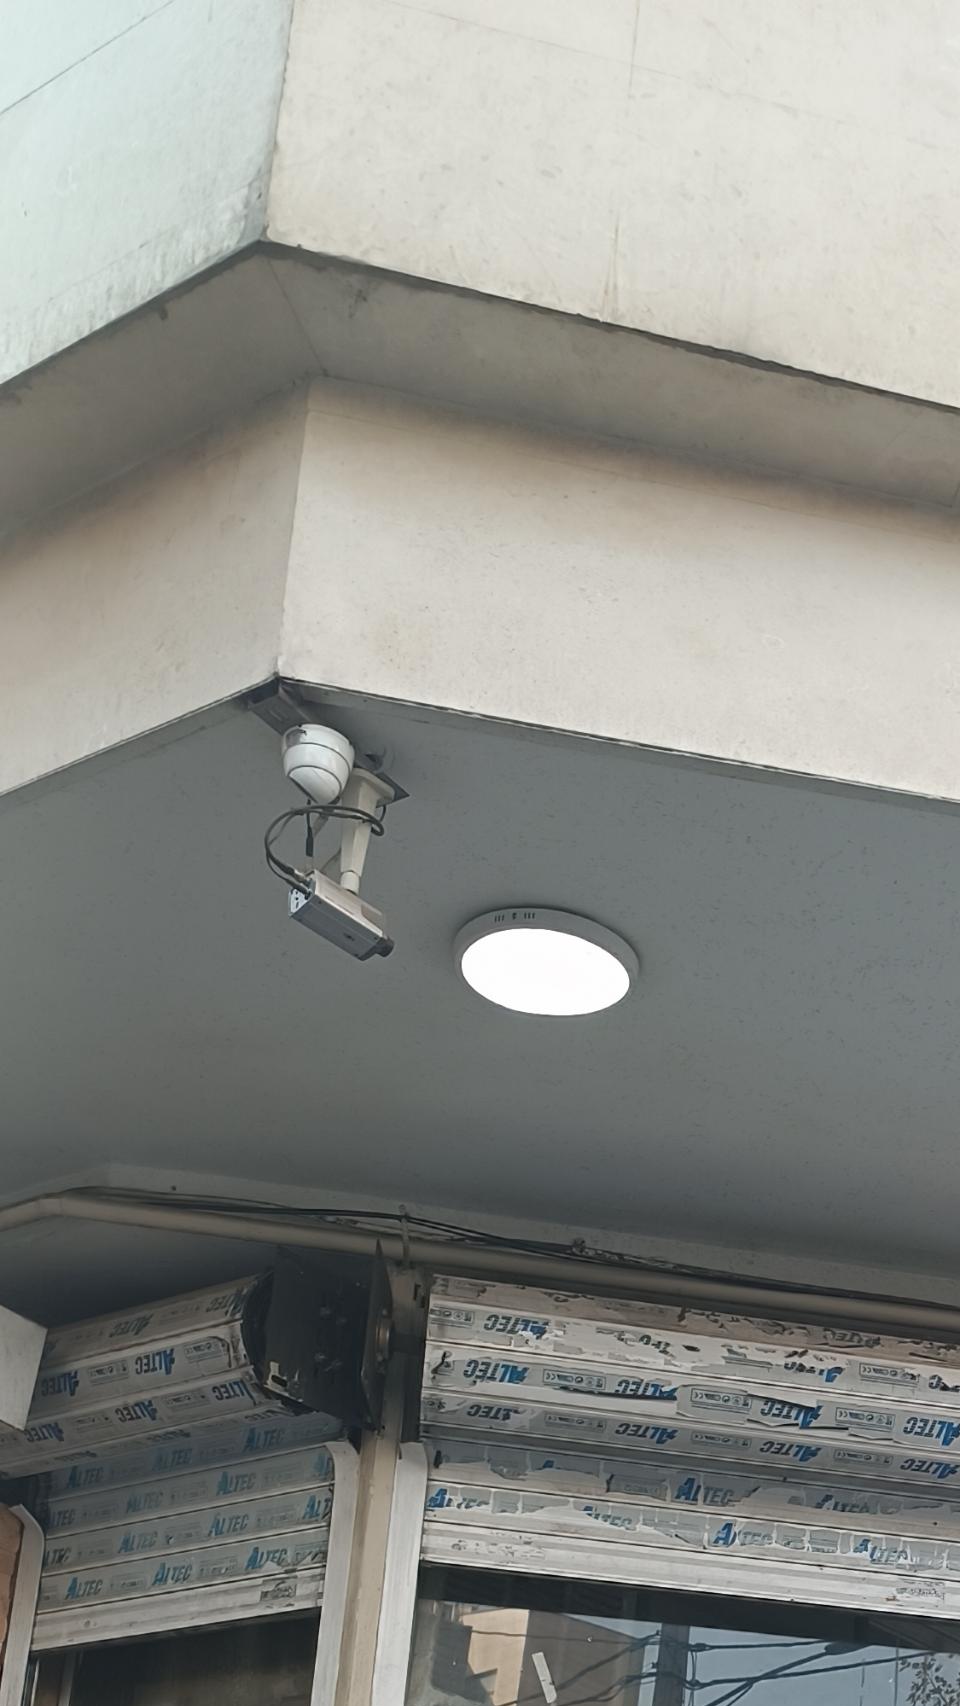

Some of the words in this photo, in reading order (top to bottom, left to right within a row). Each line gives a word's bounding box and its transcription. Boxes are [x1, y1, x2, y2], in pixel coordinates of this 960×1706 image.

[135, 1348, 175, 1375] ALTEC
[463, 1359, 530, 1385] ALTEC
[41, 1371, 79, 1396] ALTEC
[115, 1400, 158, 1422] ALTEC
[760, 1400, 823, 1430] ALTEC
[26, 1423, 64, 1442] ALTEC
[243, 1427, 283, 1451] ALTEC
[615, 1422, 679, 1445] ALTEC
[759, 1440, 822, 1463] ALTEC
[67, 1465, 104, 1489] ALTEC
[900, 1458, 960, 1480] ALTEC
[216, 1471, 256, 1497] ALTEC
[675, 1477, 736, 1507] ALTEC
[208, 1512, 249, 1538] ALTEC
[118, 1530, 157, 1554] ALTEC
[151, 1562, 192, 1587] ALTEC
[65, 1576, 103, 1601] ALTEC
